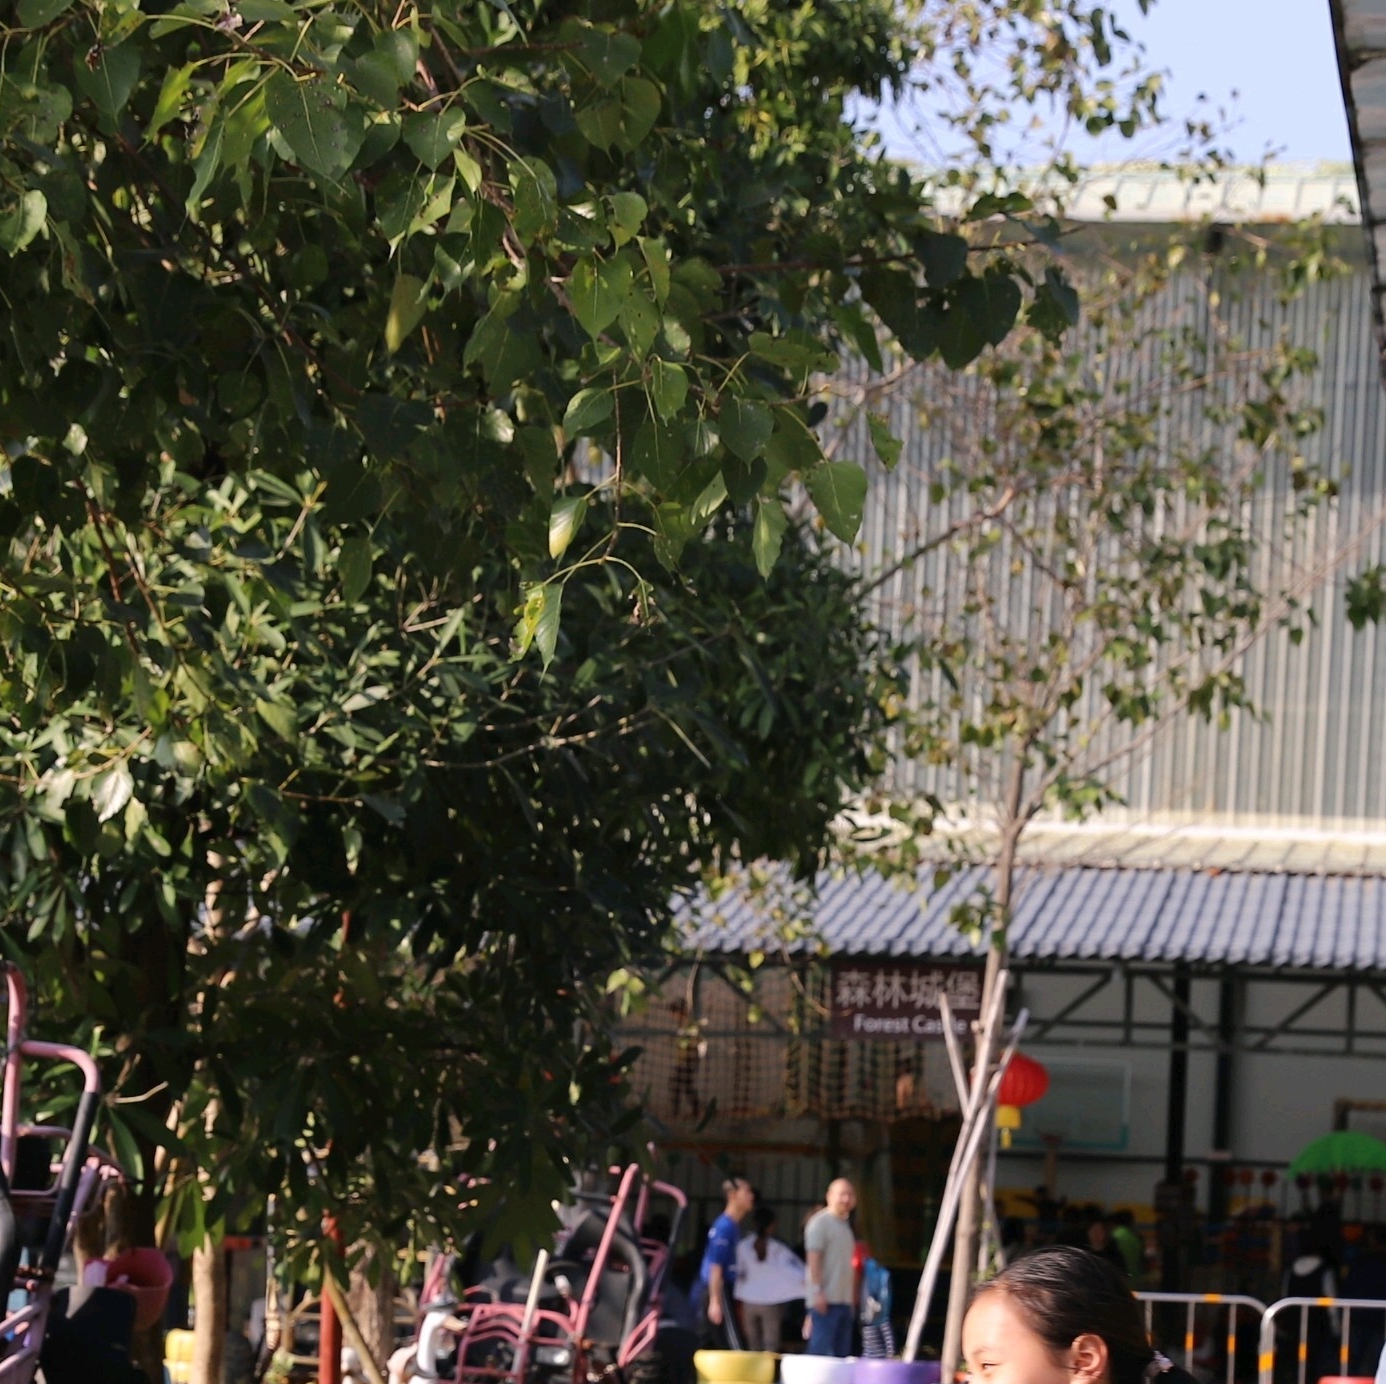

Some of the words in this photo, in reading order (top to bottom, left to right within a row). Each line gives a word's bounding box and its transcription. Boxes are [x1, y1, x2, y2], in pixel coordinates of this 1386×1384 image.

[836, 967, 980, 1010] 森林城堡
[853, 1013, 910, 1034] Forest
[912, 1014, 967, 1035] Casle
